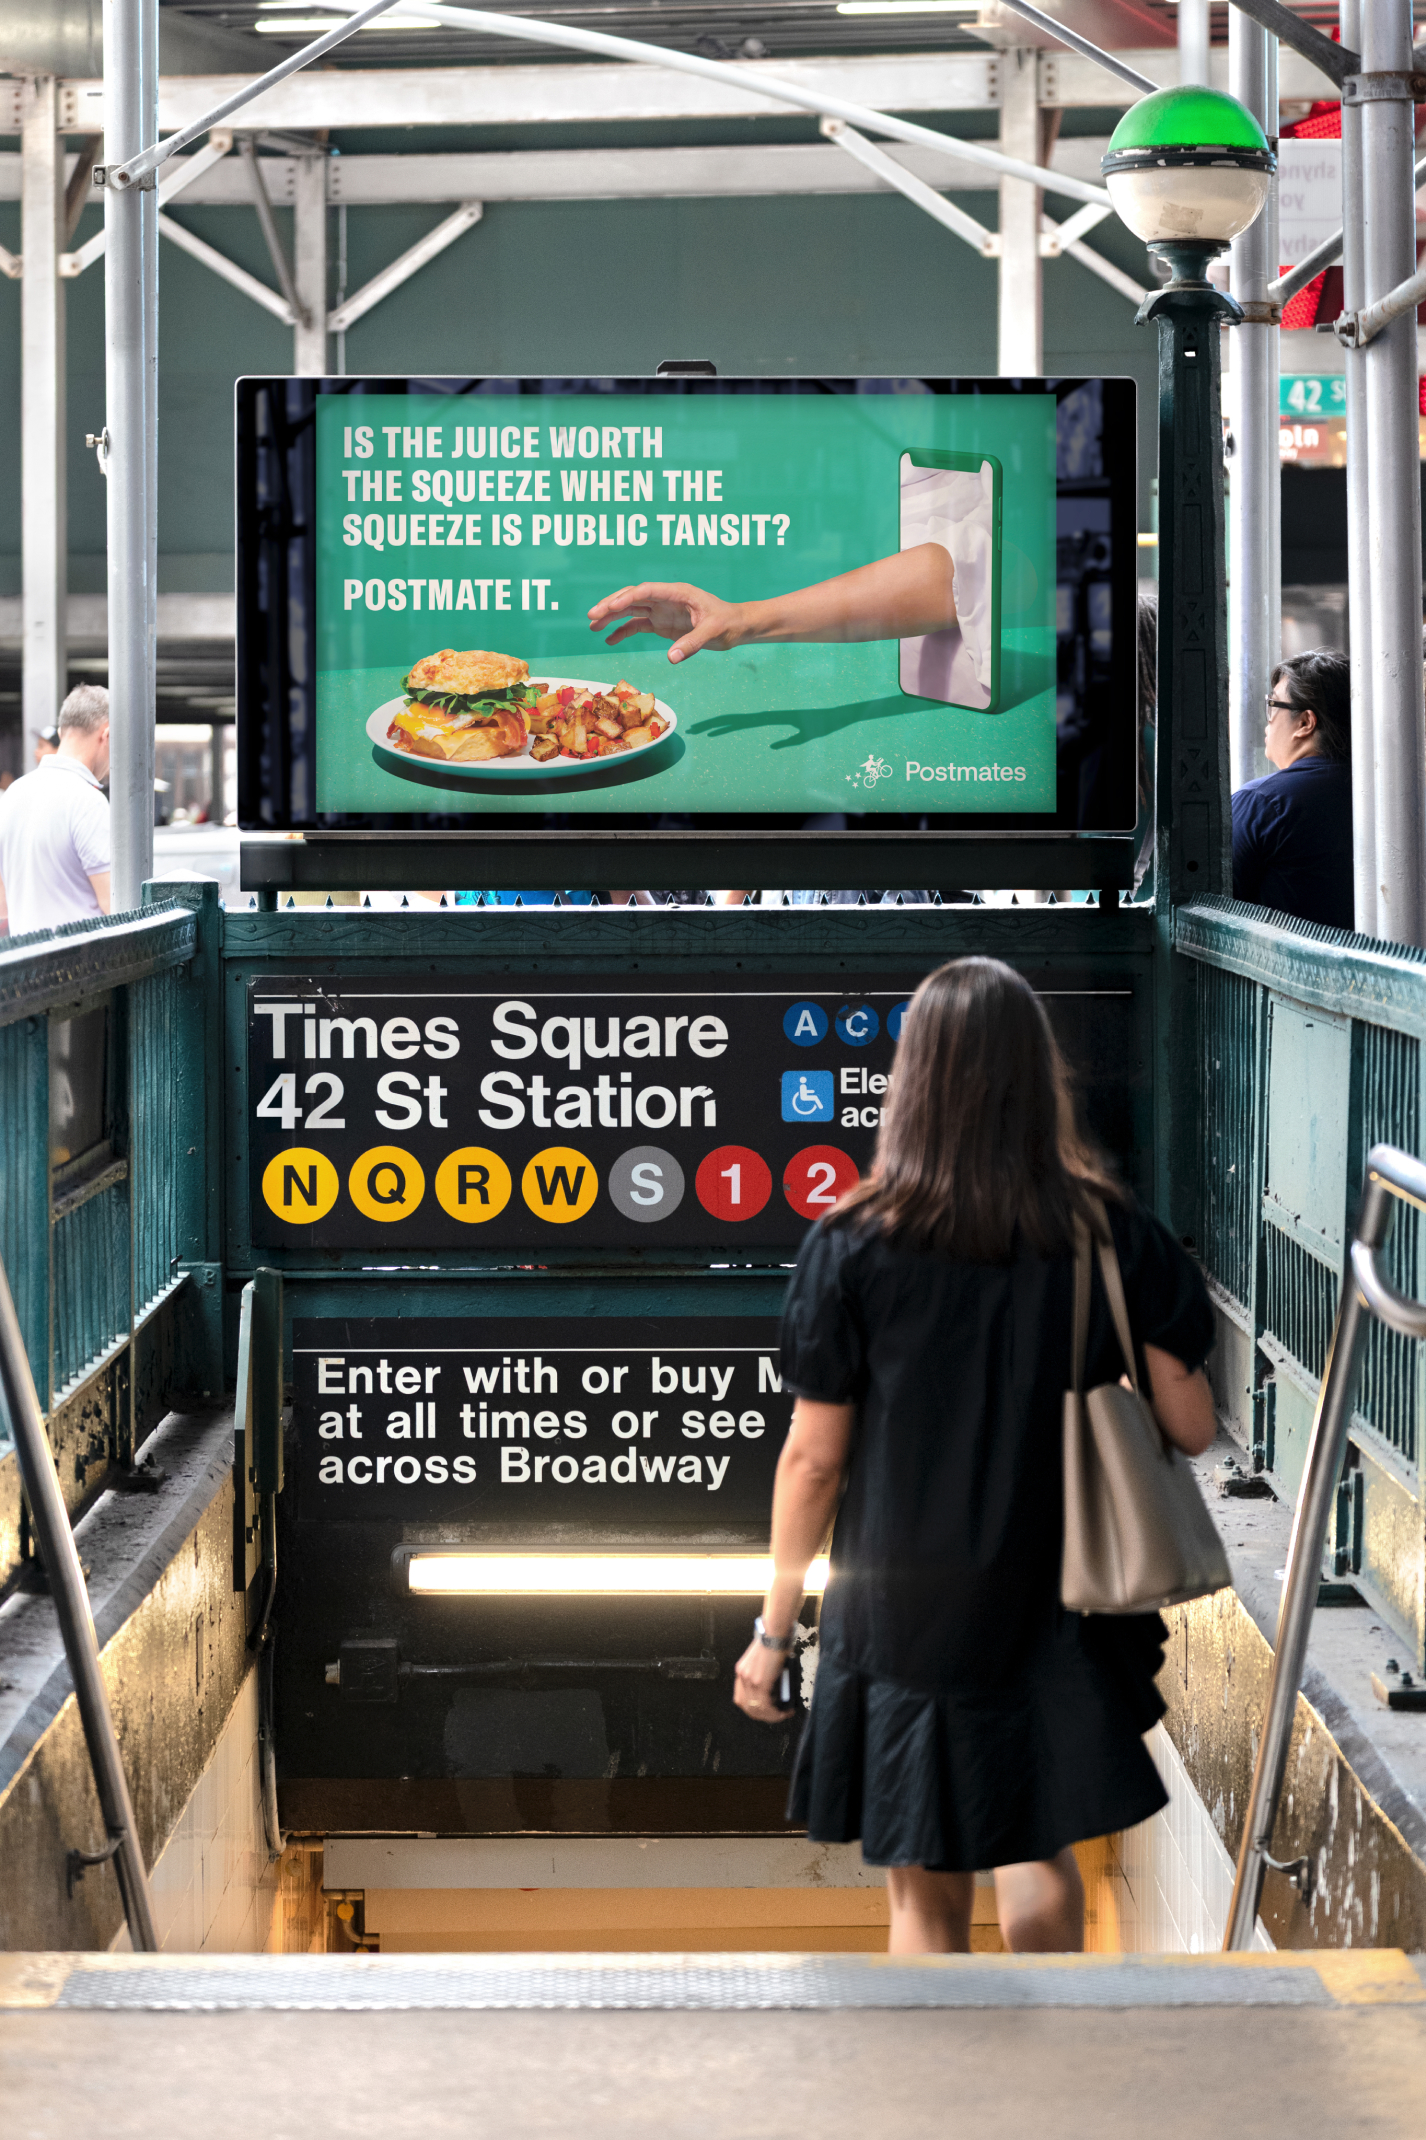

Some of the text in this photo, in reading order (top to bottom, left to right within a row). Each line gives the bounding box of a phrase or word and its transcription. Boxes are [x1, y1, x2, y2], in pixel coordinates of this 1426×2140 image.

[1287, 379, 1346, 413] 42 S
[343, 426, 664, 459] IS THE JUICE WORTH
[1279, 424, 1319, 448] oln
[343, 470, 724, 508] THE SQUEEZE WHEN THE
[343, 514, 792, 553] SQUEEZE IS PUBLIC TANSIT?
[343, 579, 560, 613] POSTMATE IT.
[905, 760, 1027, 784] Postmates
[253, 1001, 729, 1071] Times Square
[794, 1009, 819, 1037] A
[846, 1011, 869, 1038] C
[256, 1071, 718, 1130] 42 St Station
[840, 1106, 890, 1128] acr
[283, 1161, 838, 1206] N Q R W S 1 2
[317, 1357, 441, 1395] Enter
[463, 1357, 559, 1395] with
[582, 1366, 630, 1396] or
[652, 1357, 736, 1403] buy
[317, 1404, 364, 1440] at
[386, 1402, 437, 1440] all
[461, 1402, 588, 1440] times
[611, 1411, 660, 1440] or
[681, 1411, 767, 1440] see
[317, 1447, 731, 1492] across Broadway
